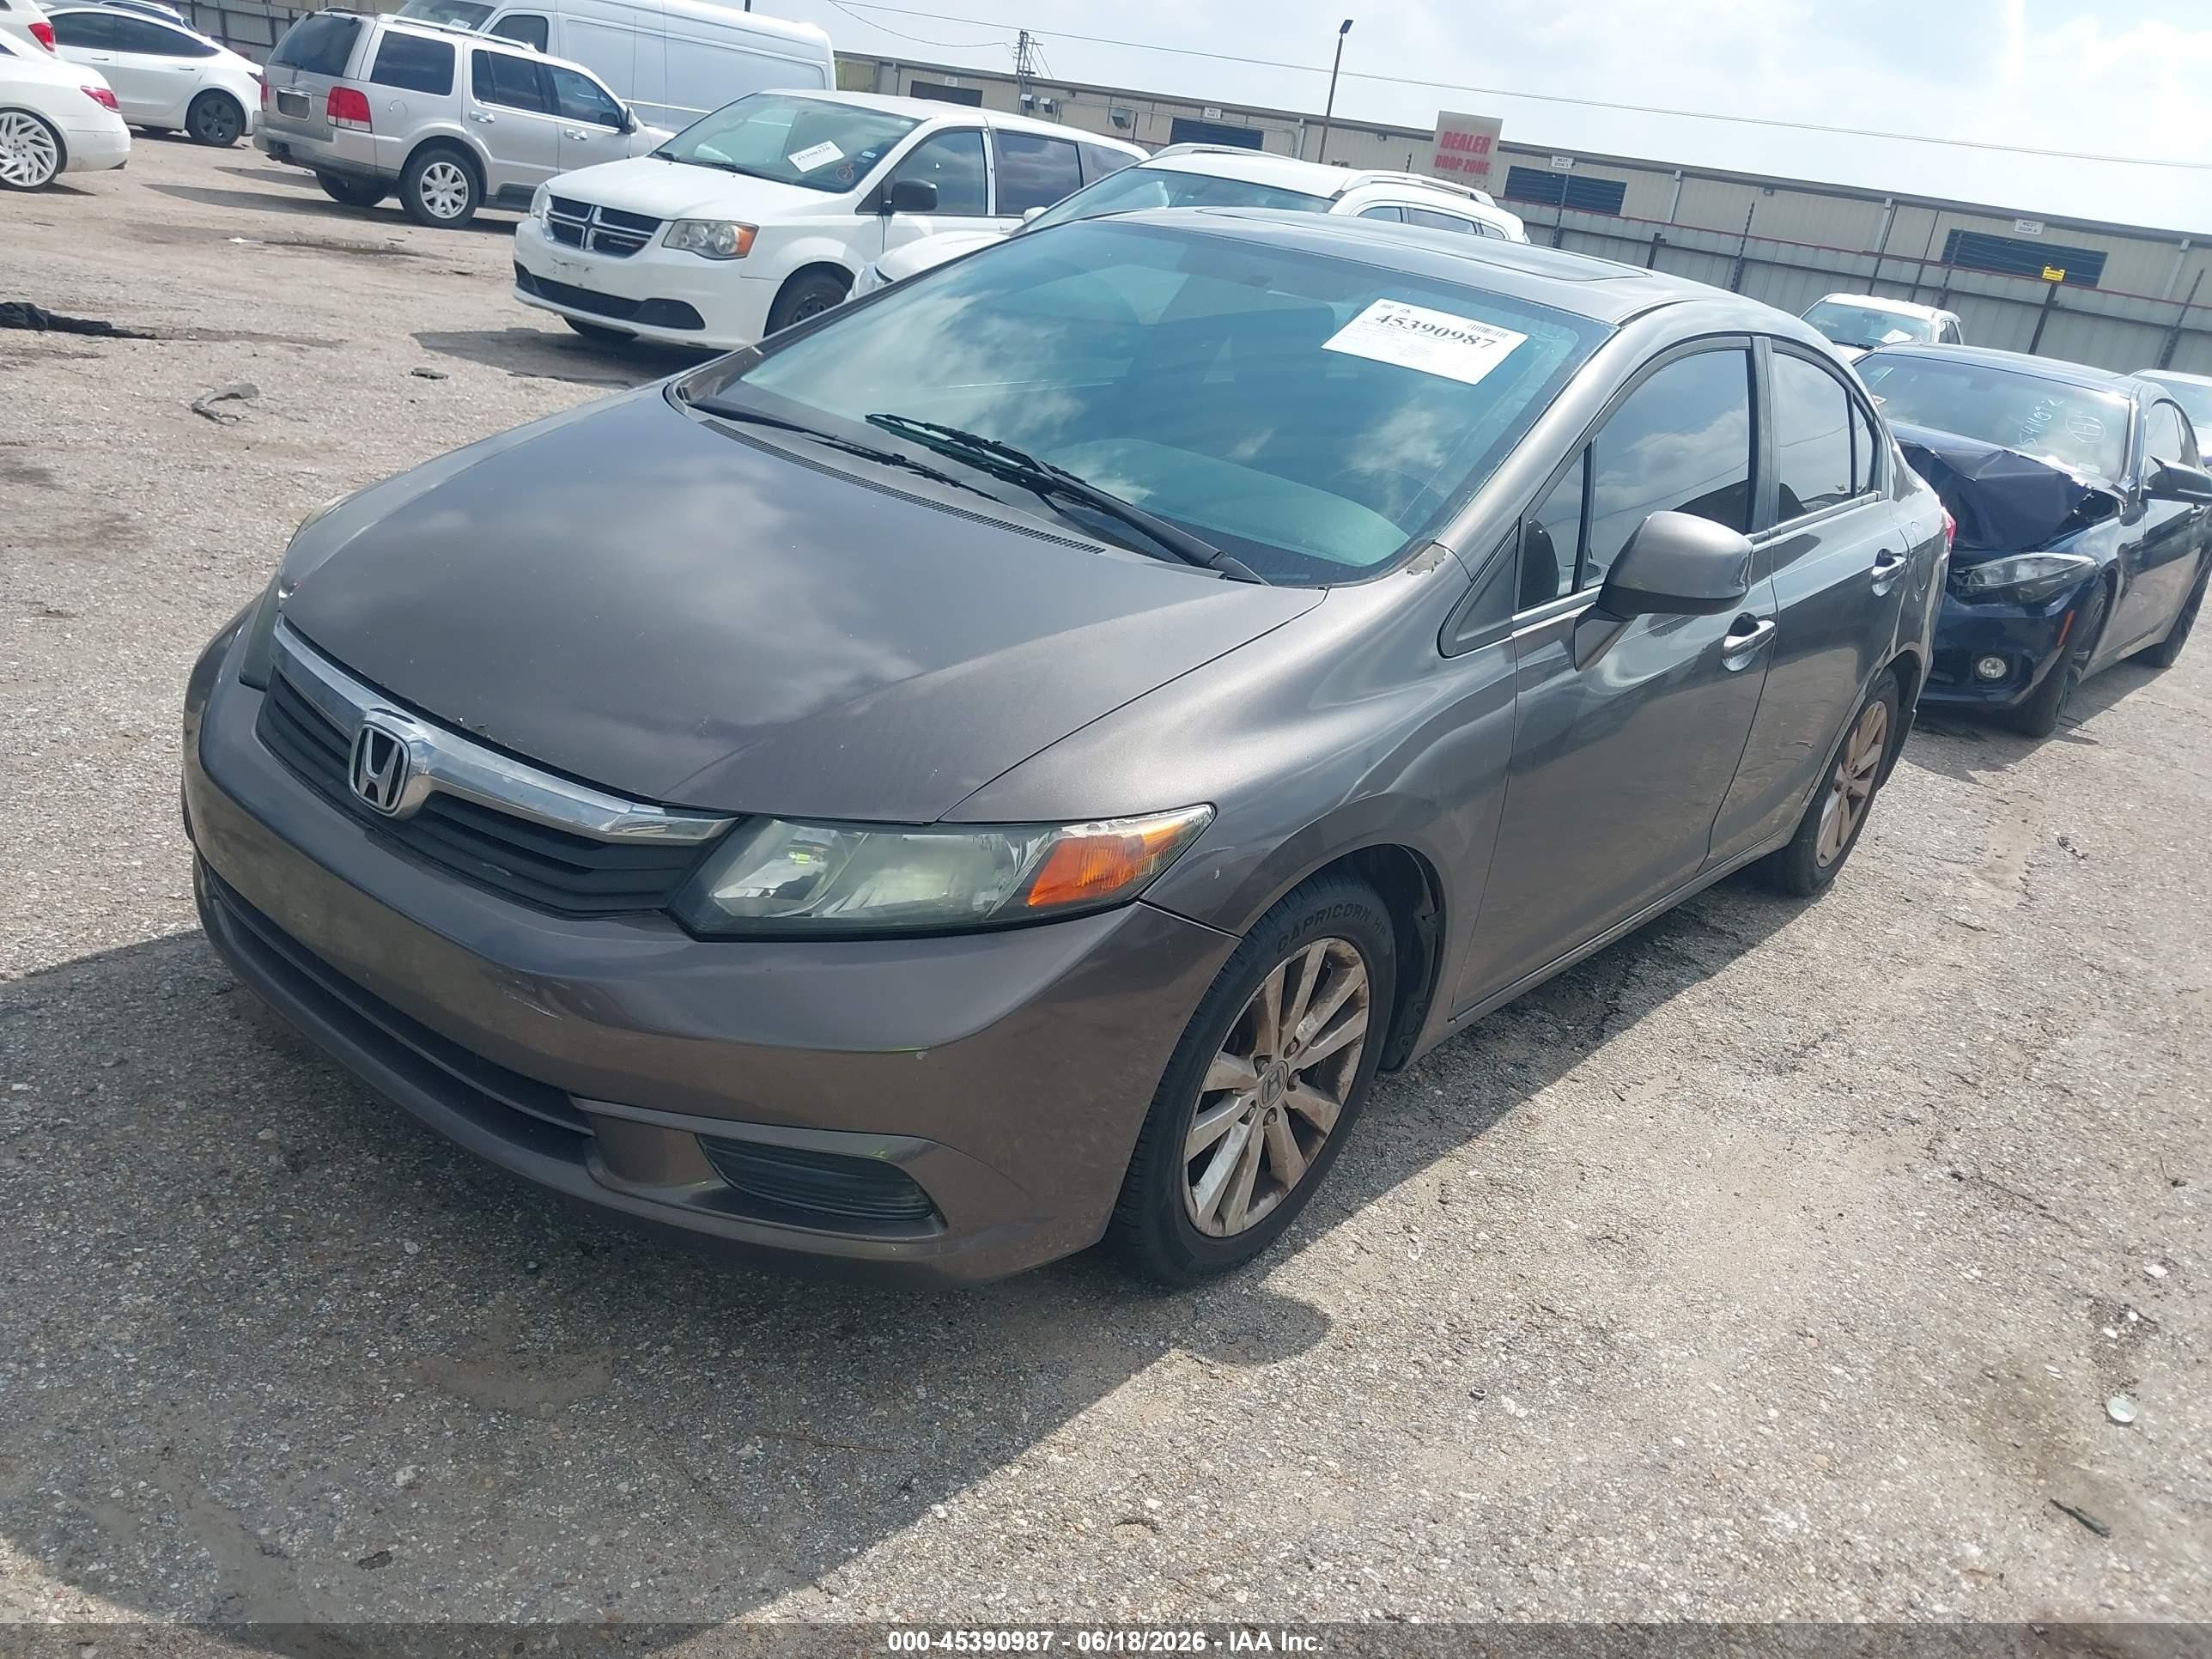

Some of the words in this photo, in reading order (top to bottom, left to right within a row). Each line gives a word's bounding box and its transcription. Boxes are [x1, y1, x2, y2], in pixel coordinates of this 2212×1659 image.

[1440, 131, 1492, 155] DEALER
[1433, 155, 1464, 171] DROP
[1462, 159, 1491, 175] ZONE
[1375, 314, 1498, 349] 45390987
[1277, 902, 1372, 954] CAPRICORN
